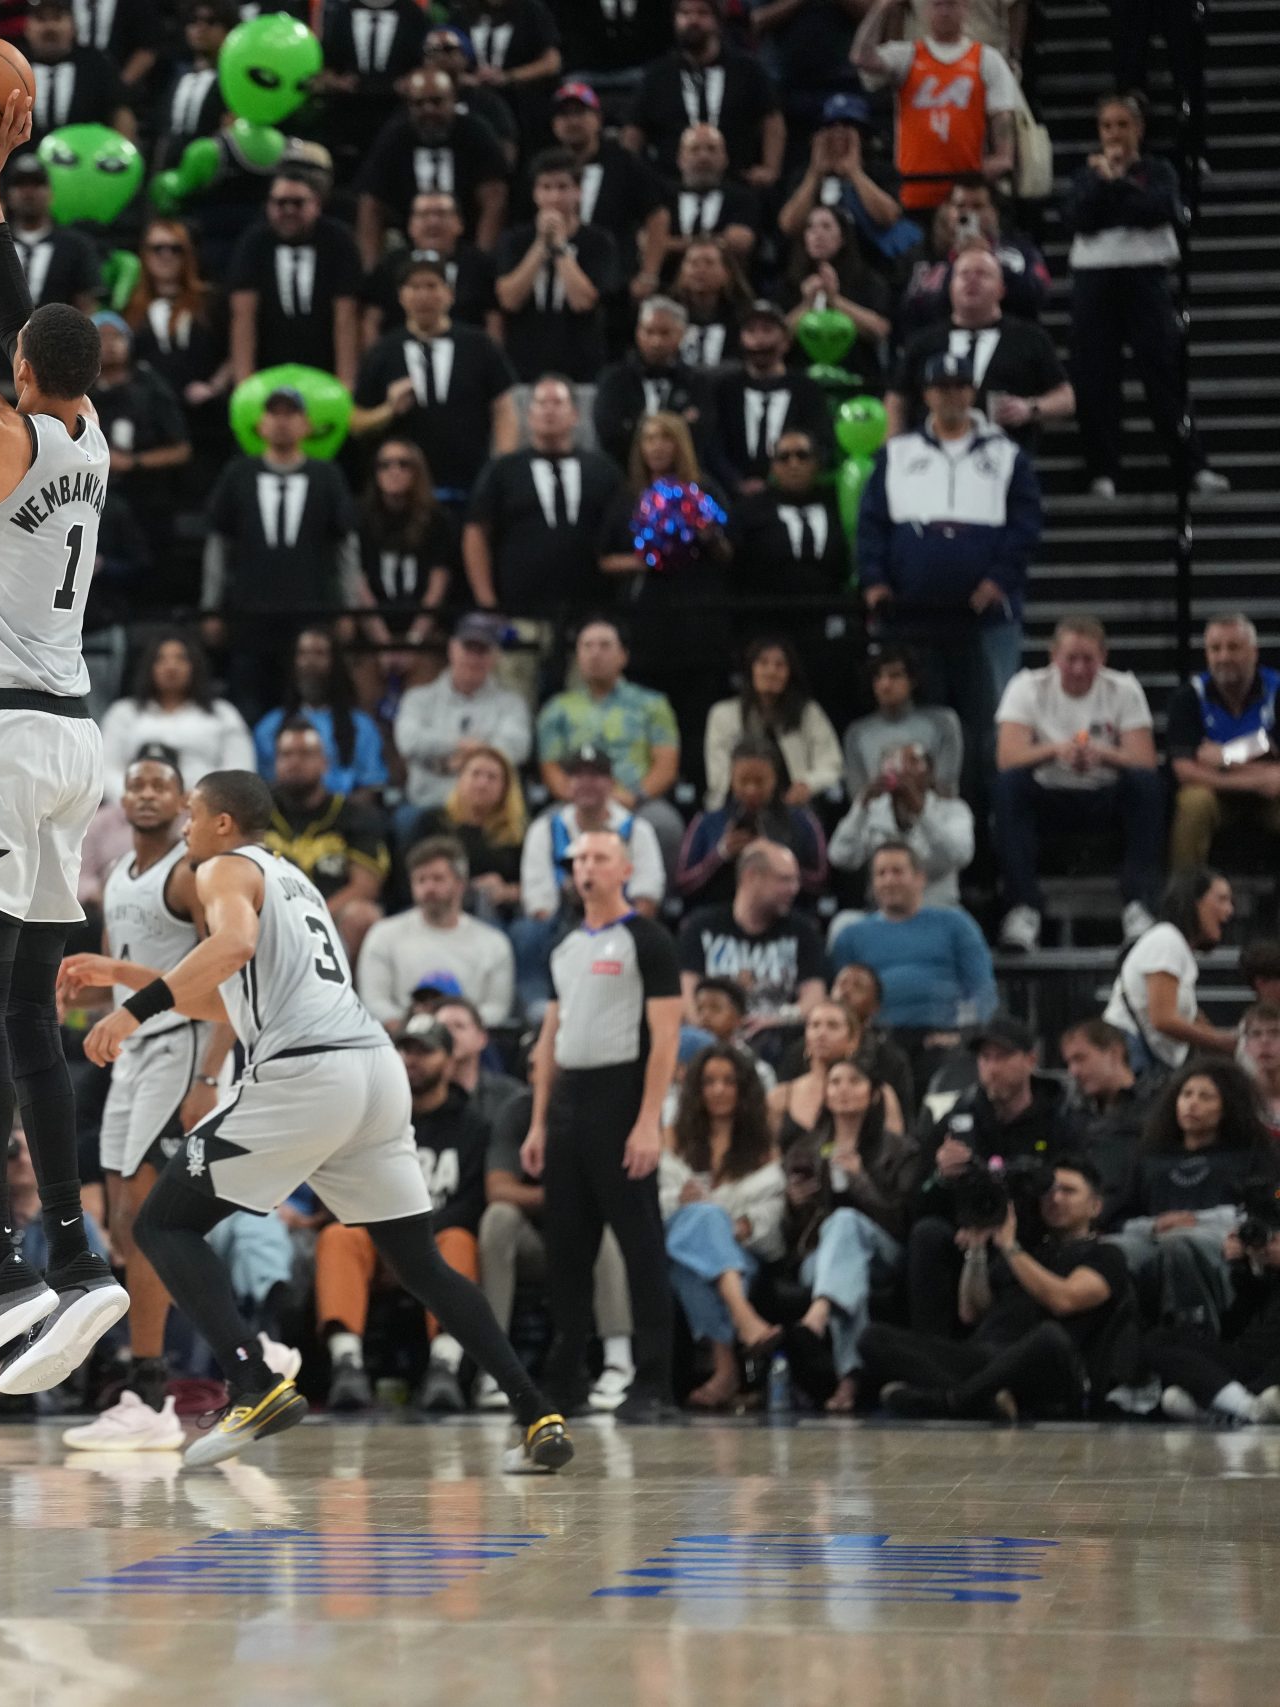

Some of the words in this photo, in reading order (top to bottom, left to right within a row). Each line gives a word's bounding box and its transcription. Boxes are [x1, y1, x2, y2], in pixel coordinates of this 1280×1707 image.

[913, 75, 974, 110] LA
[9, 472, 105, 534] WEMBANYA
[51, 521, 86, 613] 1
[304, 912, 347, 986] 3
